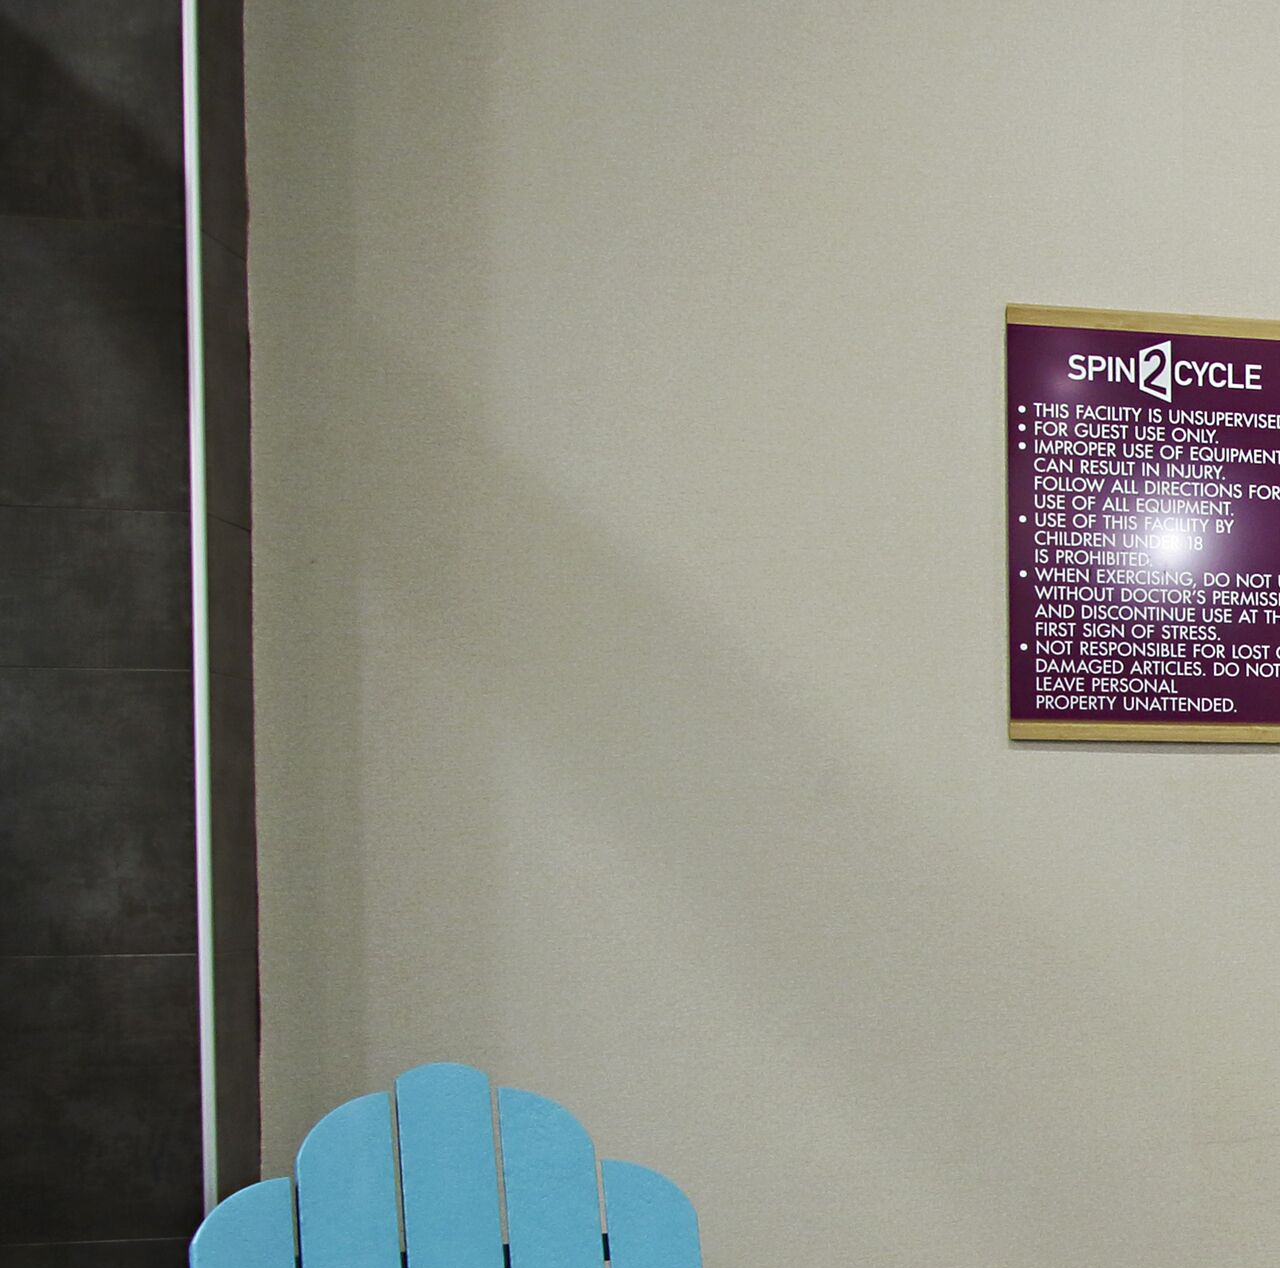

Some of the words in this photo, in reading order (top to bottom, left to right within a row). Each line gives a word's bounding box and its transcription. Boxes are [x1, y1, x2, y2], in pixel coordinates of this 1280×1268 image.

[1034, 403, 1069, 419] THIS
[1076, 405, 1142, 422] FACILITY
[1149, 408, 1162, 423] IS
[1034, 421, 1068, 436] FOR
[1074, 423, 1128, 439] GUEST
[1135, 426, 1165, 441] USE
[1172, 428, 1219, 444] ONLY.
[1034, 440, 1116, 457] IMPROPER
[1123, 443, 1154, 458] USE
[1160, 445, 1183, 460] OF
[1034, 458, 1073, 473] CAN
[1080, 460, 1135, 476] RESULT
[1142, 463, 1160, 476] IN
[1167, 464, 1226, 480] INJURY.
[1034, 476, 1104, 492] FOLLOW
[1111, 479, 1139, 494] ALL
[1145, 481, 1242, 498] DIRECTIONS
[1249, 485, 1280, 500] FOR
[1034, 495, 1065, 510] USE
[1072, 496, 1096, 510] OF
[1103, 498, 1129, 512] ALL
[1136, 499, 1234, 516] EQUIPMENT.
[1034, 513, 1066, 528] USE
[1072, 515, 1097, 528] OF
[1103, 516, 1138, 530] THIS
[1144, 517, 1209, 533] FACILITY
[1215, 520, 1234, 533] BY
[1034, 531, 1116, 548] CHILDREN
[1188, 536, 1203, 550] 18
[1035, 550, 1049, 563] IS
[1056, 551, 1153, 567] PROHIBITED.
[1035, 568, 1089, 583] WHEN
[1203, 573, 1230, 588] DO
[1236, 574, 1272, 589] NOT
[1035, 586, 1115, 602] WITHOUT
[1121, 588, 1206, 605] DOCTOR'S
[1035, 605, 1075, 619] AND
[1081, 606, 1196, 622] DISCONTINUE
[1202, 609, 1232, 623] USE
[1238, 610, 1258, 624] AT
[1035, 623, 1076, 637] FIRST
[1082, 624, 1125, 638] SIGN
[1131, 625, 1155, 639] OF
[1161, 626, 1221, 641] STRESS.
[1035, 641, 1073, 655] NOT
[1080, 642, 1186, 658] RESPONSIBLE
[1193, 644, 1225, 658] FOR
[1232, 645, 1270, 659] LOST
[1035, 659, 1124, 674] DAMAGED
[1130, 661, 1206, 676] ARTICLES.
[1213, 663, 1239, 677] DO
[1245, 663, 1280, 678] NOT
[1035, 677, 1085, 692] LEAVE
[1092, 678, 1178, 694] PERSONAL
[1035, 695, 1117, 710] PROPERTY
[1123, 697, 1237, 713] UNATTENDED.
